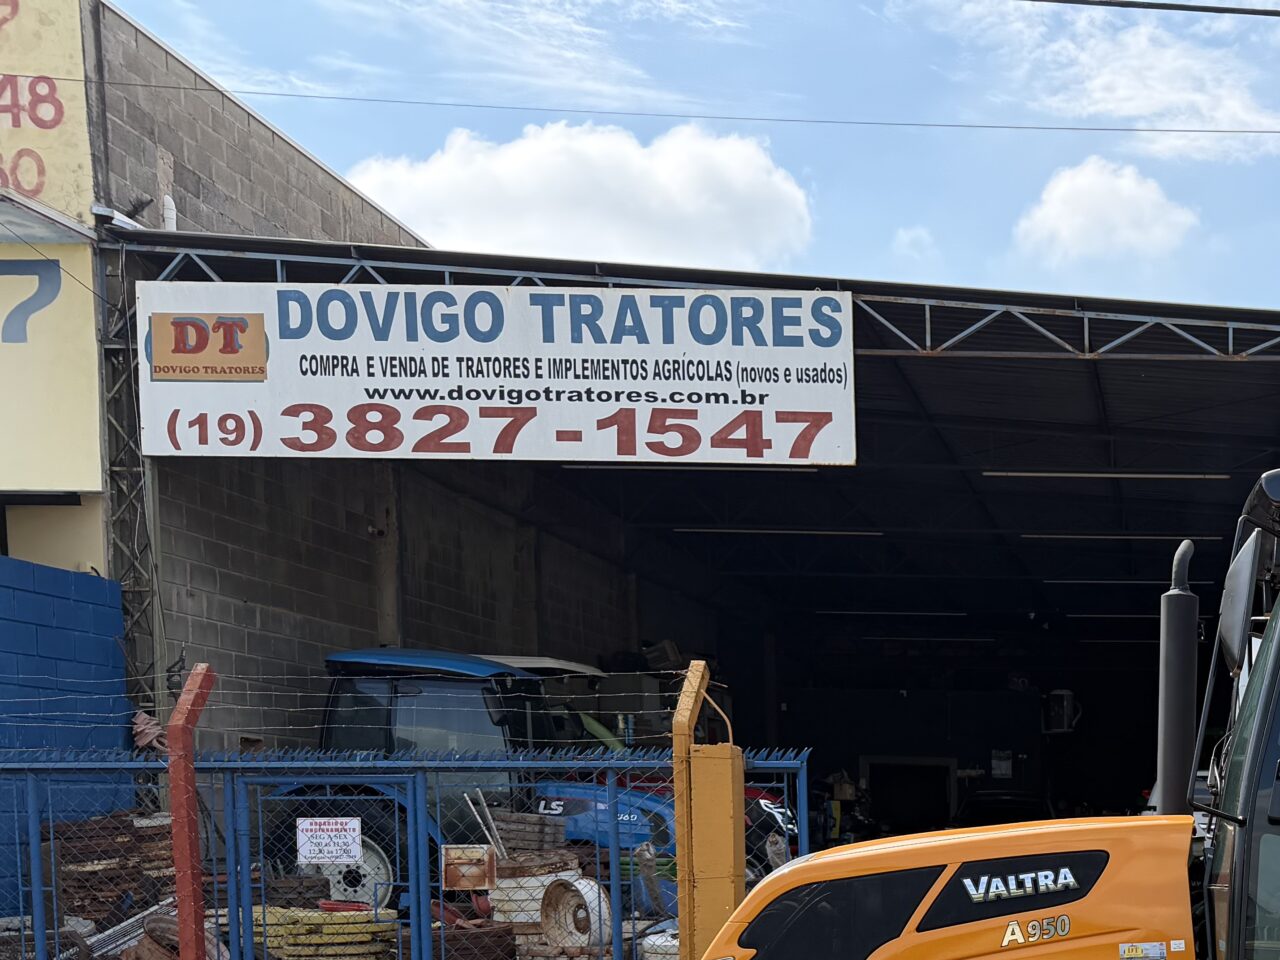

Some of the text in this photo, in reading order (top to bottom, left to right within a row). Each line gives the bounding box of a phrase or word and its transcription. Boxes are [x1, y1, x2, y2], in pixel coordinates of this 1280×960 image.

[170, 315, 249, 355] DT
[276, 288, 843, 347] DOVIGO TRATORES
[152, 364, 266, 376] DOVIGO TRATORES
[299, 353, 849, 390] COMPRA E VENDA DE TRATORES E IMPLEMENTOS AGRÍCOLAS (novos e usados)
[363, 384, 770, 406] www.dovigotratores.com.br
[166, 408, 264, 452] (19)
[538, 800, 565, 815] LS
[963, 867, 1079, 904] VALTRA
